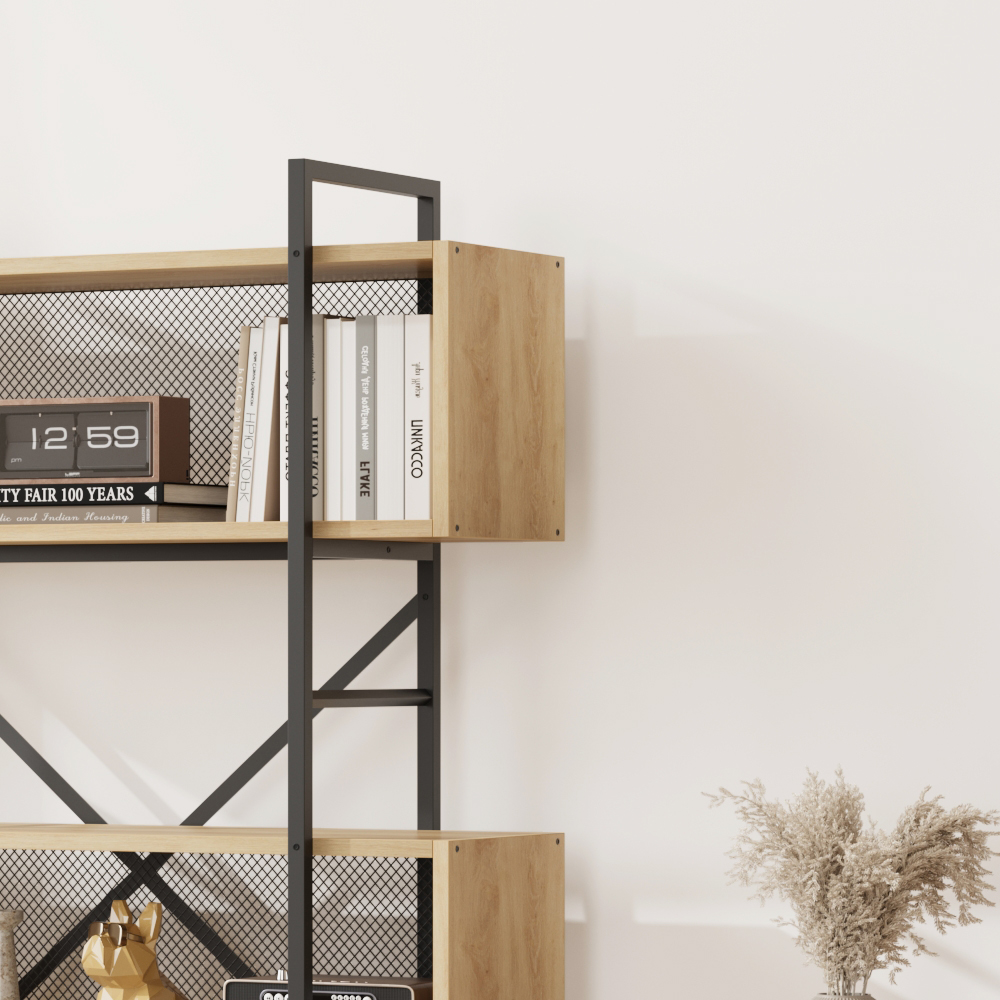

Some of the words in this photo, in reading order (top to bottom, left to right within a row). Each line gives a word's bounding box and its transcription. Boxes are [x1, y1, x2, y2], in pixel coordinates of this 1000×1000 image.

[31, 427, 68, 450] 12
[86, 425, 140, 450] 59
[24, 488, 57, 503] FAIR
[61, 487, 83, 502] 100
[87, 486, 134, 502] YEARS
[16, 513, 37, 522] and
[42, 512, 80, 522] Indian
[83, 511, 129, 524] Housing
